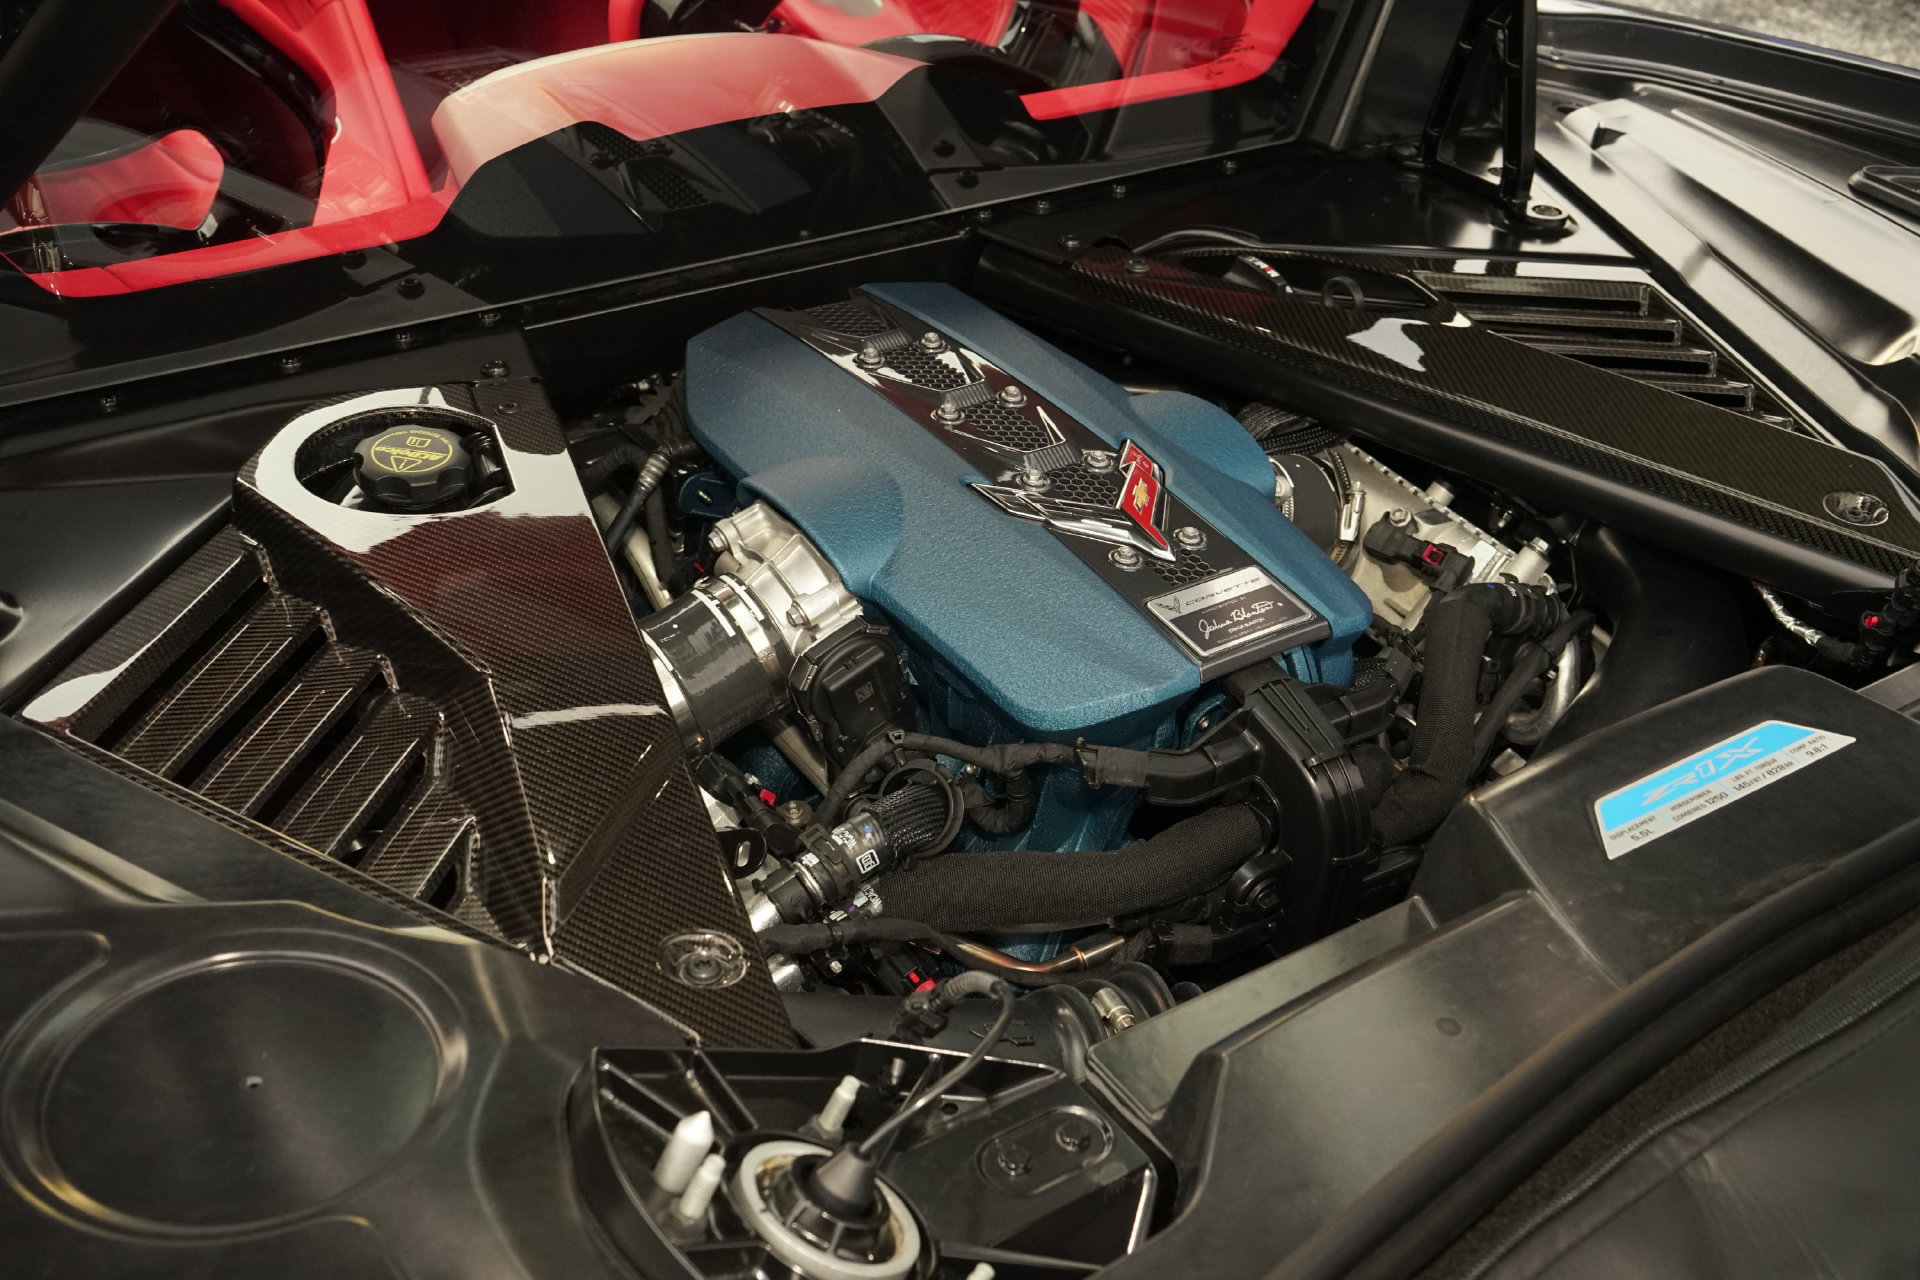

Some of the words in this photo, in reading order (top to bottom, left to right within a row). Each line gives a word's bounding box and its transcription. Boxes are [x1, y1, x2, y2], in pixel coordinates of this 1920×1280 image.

[1185, 577, 1261, 606] CORVETTE
[1704, 790, 1730, 807] 1250
[1629, 827, 1657, 843] 5.5L
